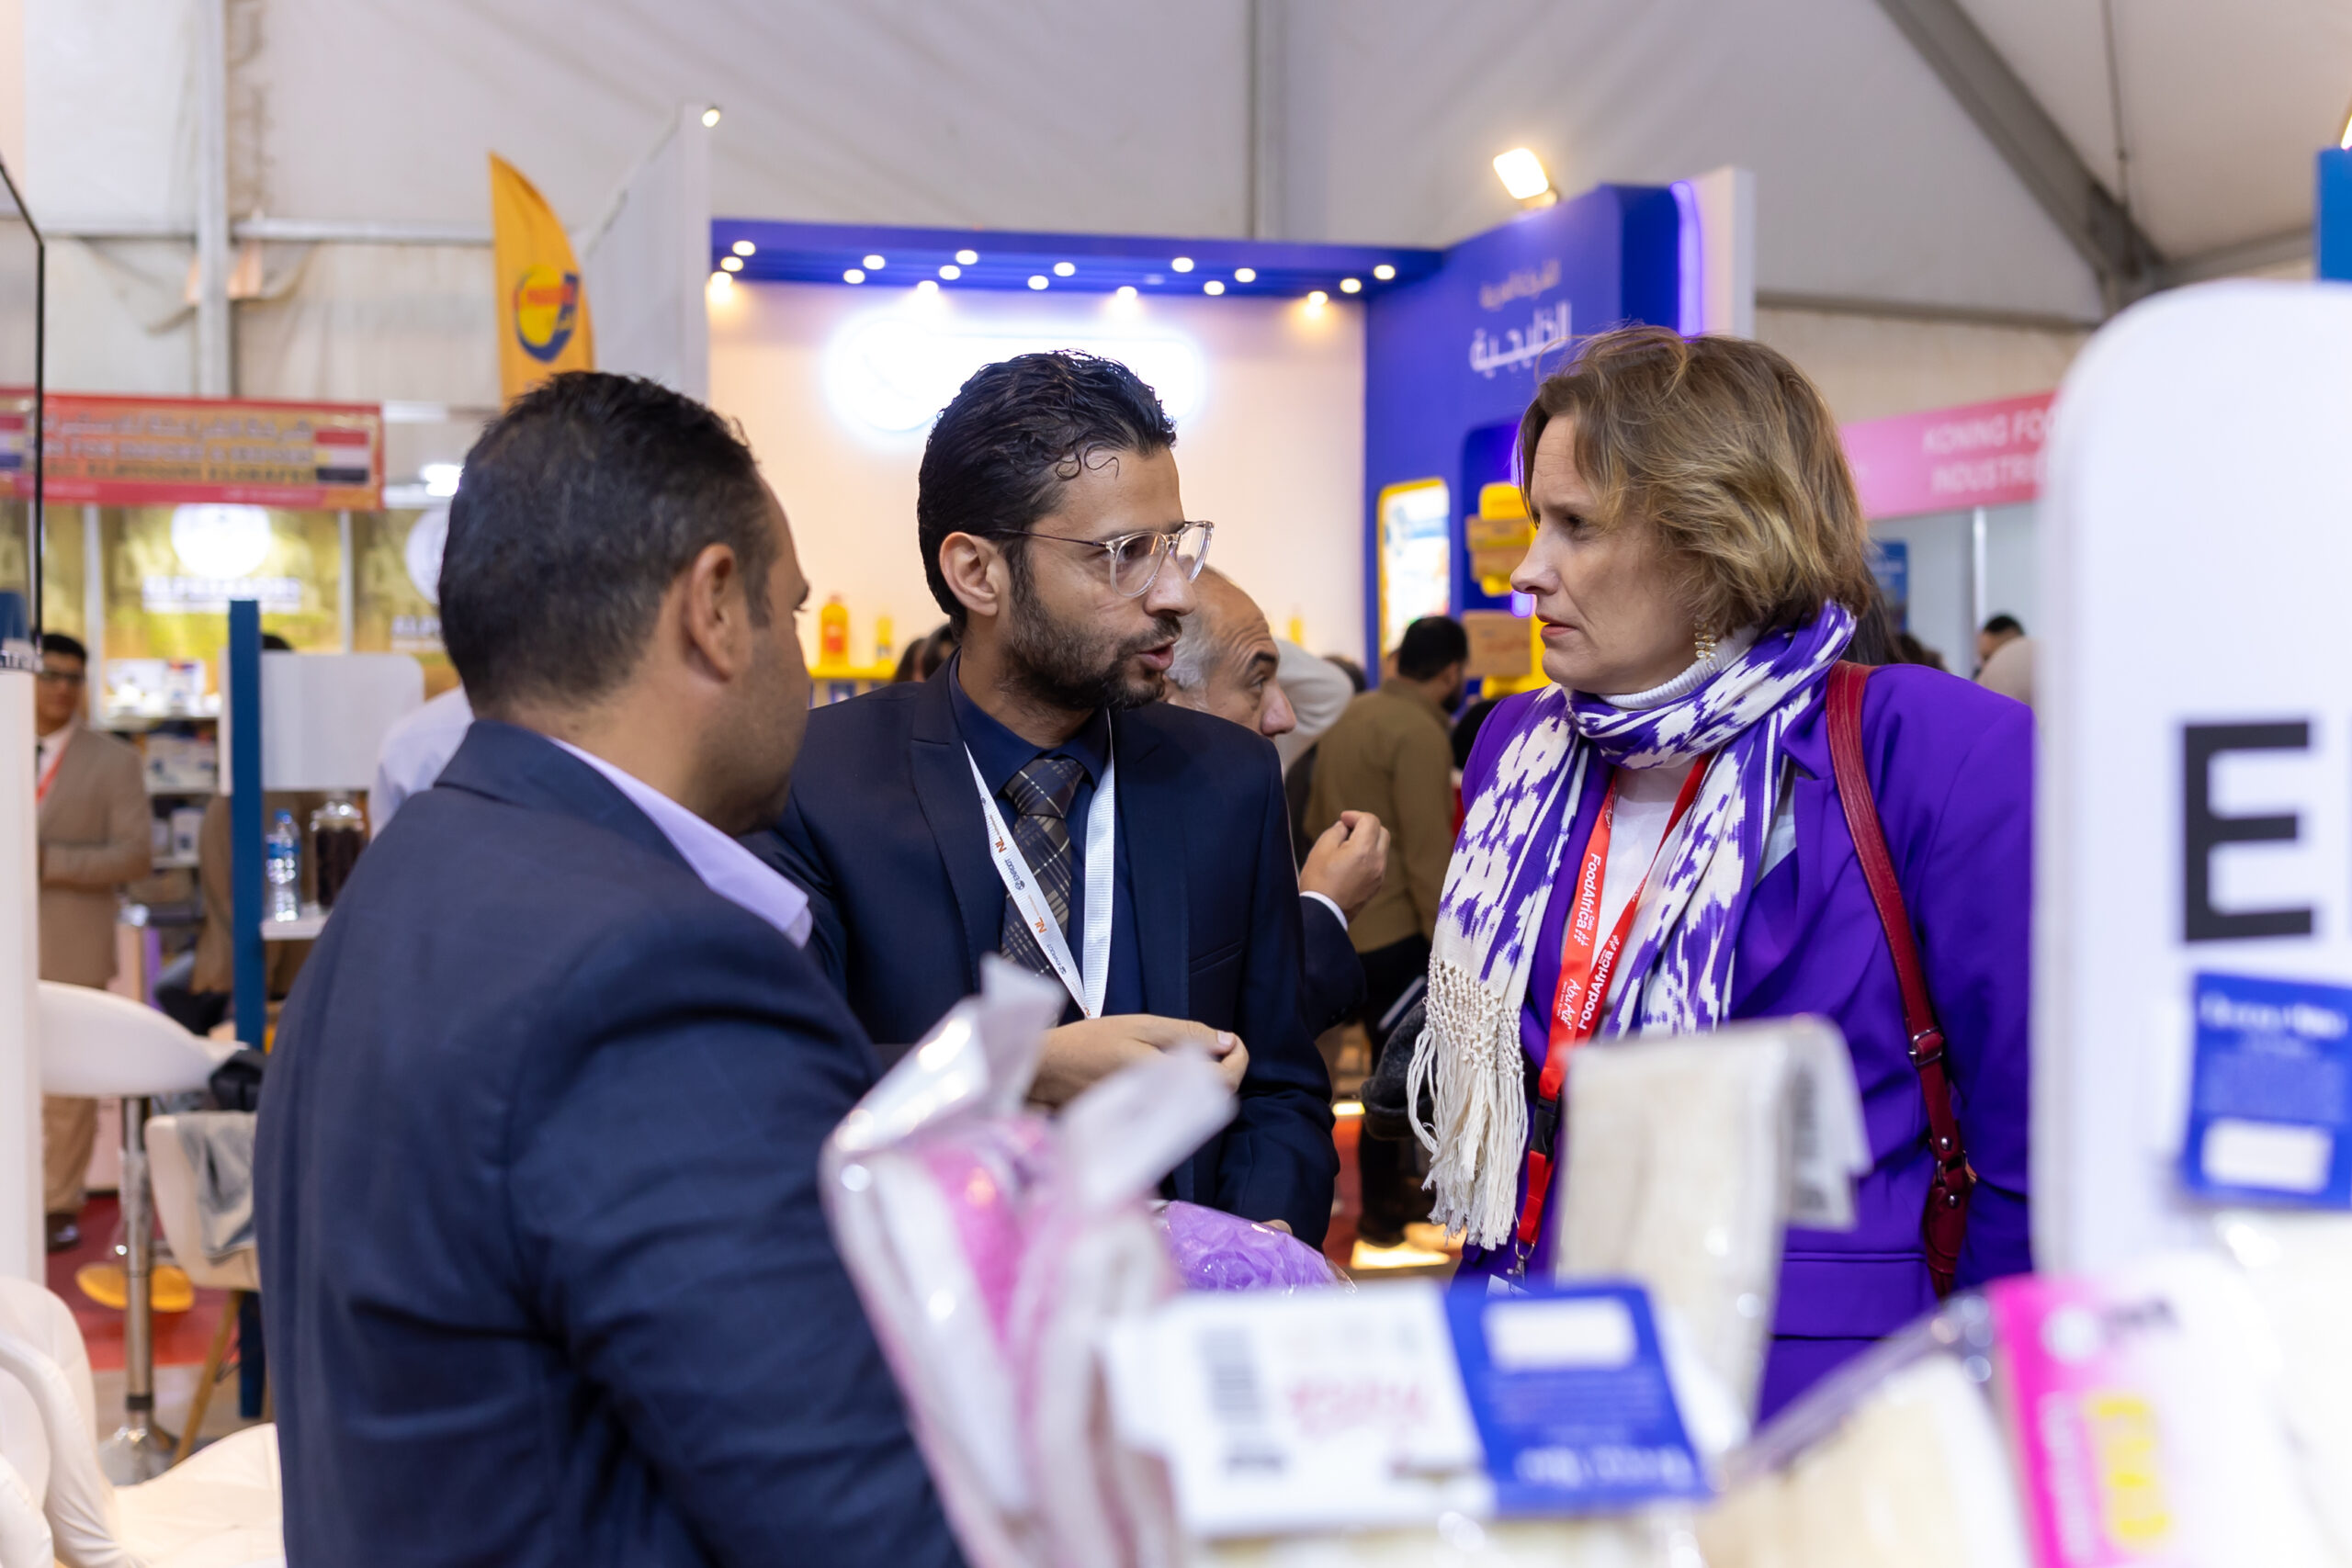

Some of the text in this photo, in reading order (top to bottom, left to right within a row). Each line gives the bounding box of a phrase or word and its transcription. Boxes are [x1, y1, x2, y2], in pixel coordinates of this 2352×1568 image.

[995, 836, 1007, 853] NL
[2184, 720, 2312, 942] E
[1576, 852, 1601, 930] FoodAfrica
[1035, 917, 1047, 934] NL
